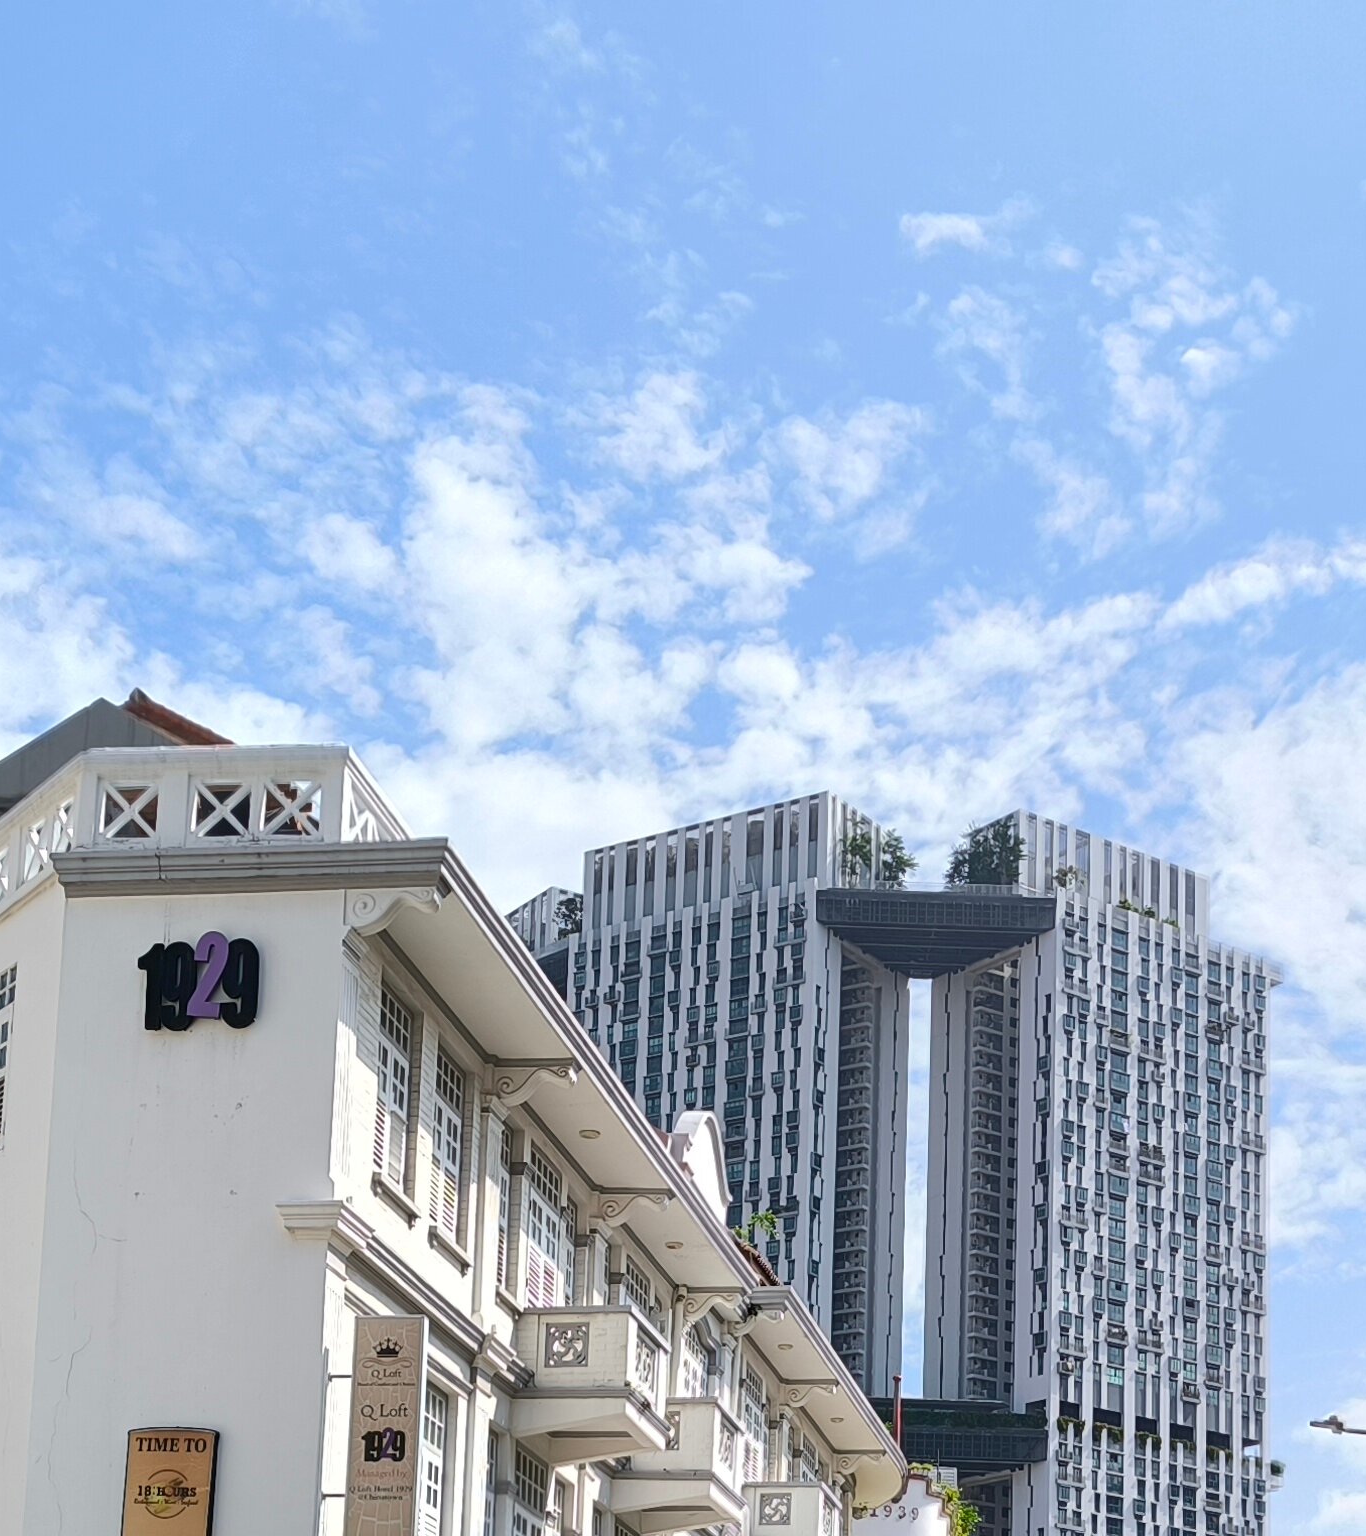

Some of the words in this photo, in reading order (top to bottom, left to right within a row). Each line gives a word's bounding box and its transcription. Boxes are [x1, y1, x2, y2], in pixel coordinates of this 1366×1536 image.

[138, 931, 260, 1031] 1929
[371, 1370, 382, 1380] Q
[383, 1368, 402, 1377] Loft
[361, 1405, 378, 1422] Q
[380, 1403, 409, 1417] Loft
[136, 1437, 180, 1452] TIME
[184, 1438, 207, 1453] TO
[361, 1427, 406, 1462] 1929
[869, 1505, 919, 1520] 1939
